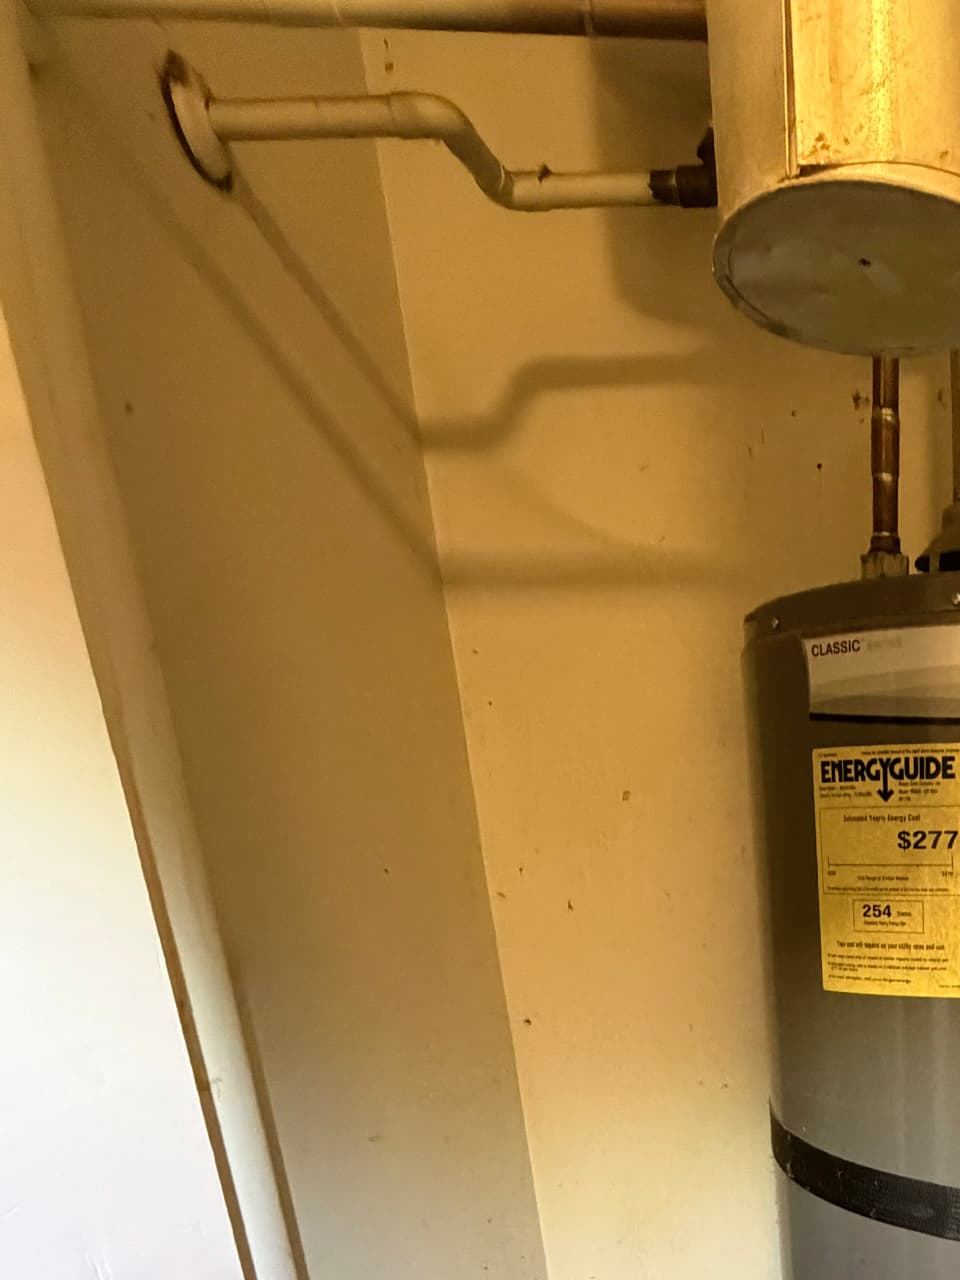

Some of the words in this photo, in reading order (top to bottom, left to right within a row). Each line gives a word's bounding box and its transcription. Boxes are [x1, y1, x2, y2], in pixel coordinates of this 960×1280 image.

[811, 639, 861, 657] CLASSIC
[820, 755, 956, 784] ENERGYGUIDE
[887, 814, 906, 824] Energy
[908, 813, 921, 822] Cost
[897, 830, 959, 851] $277
[862, 904, 892, 918] 254
